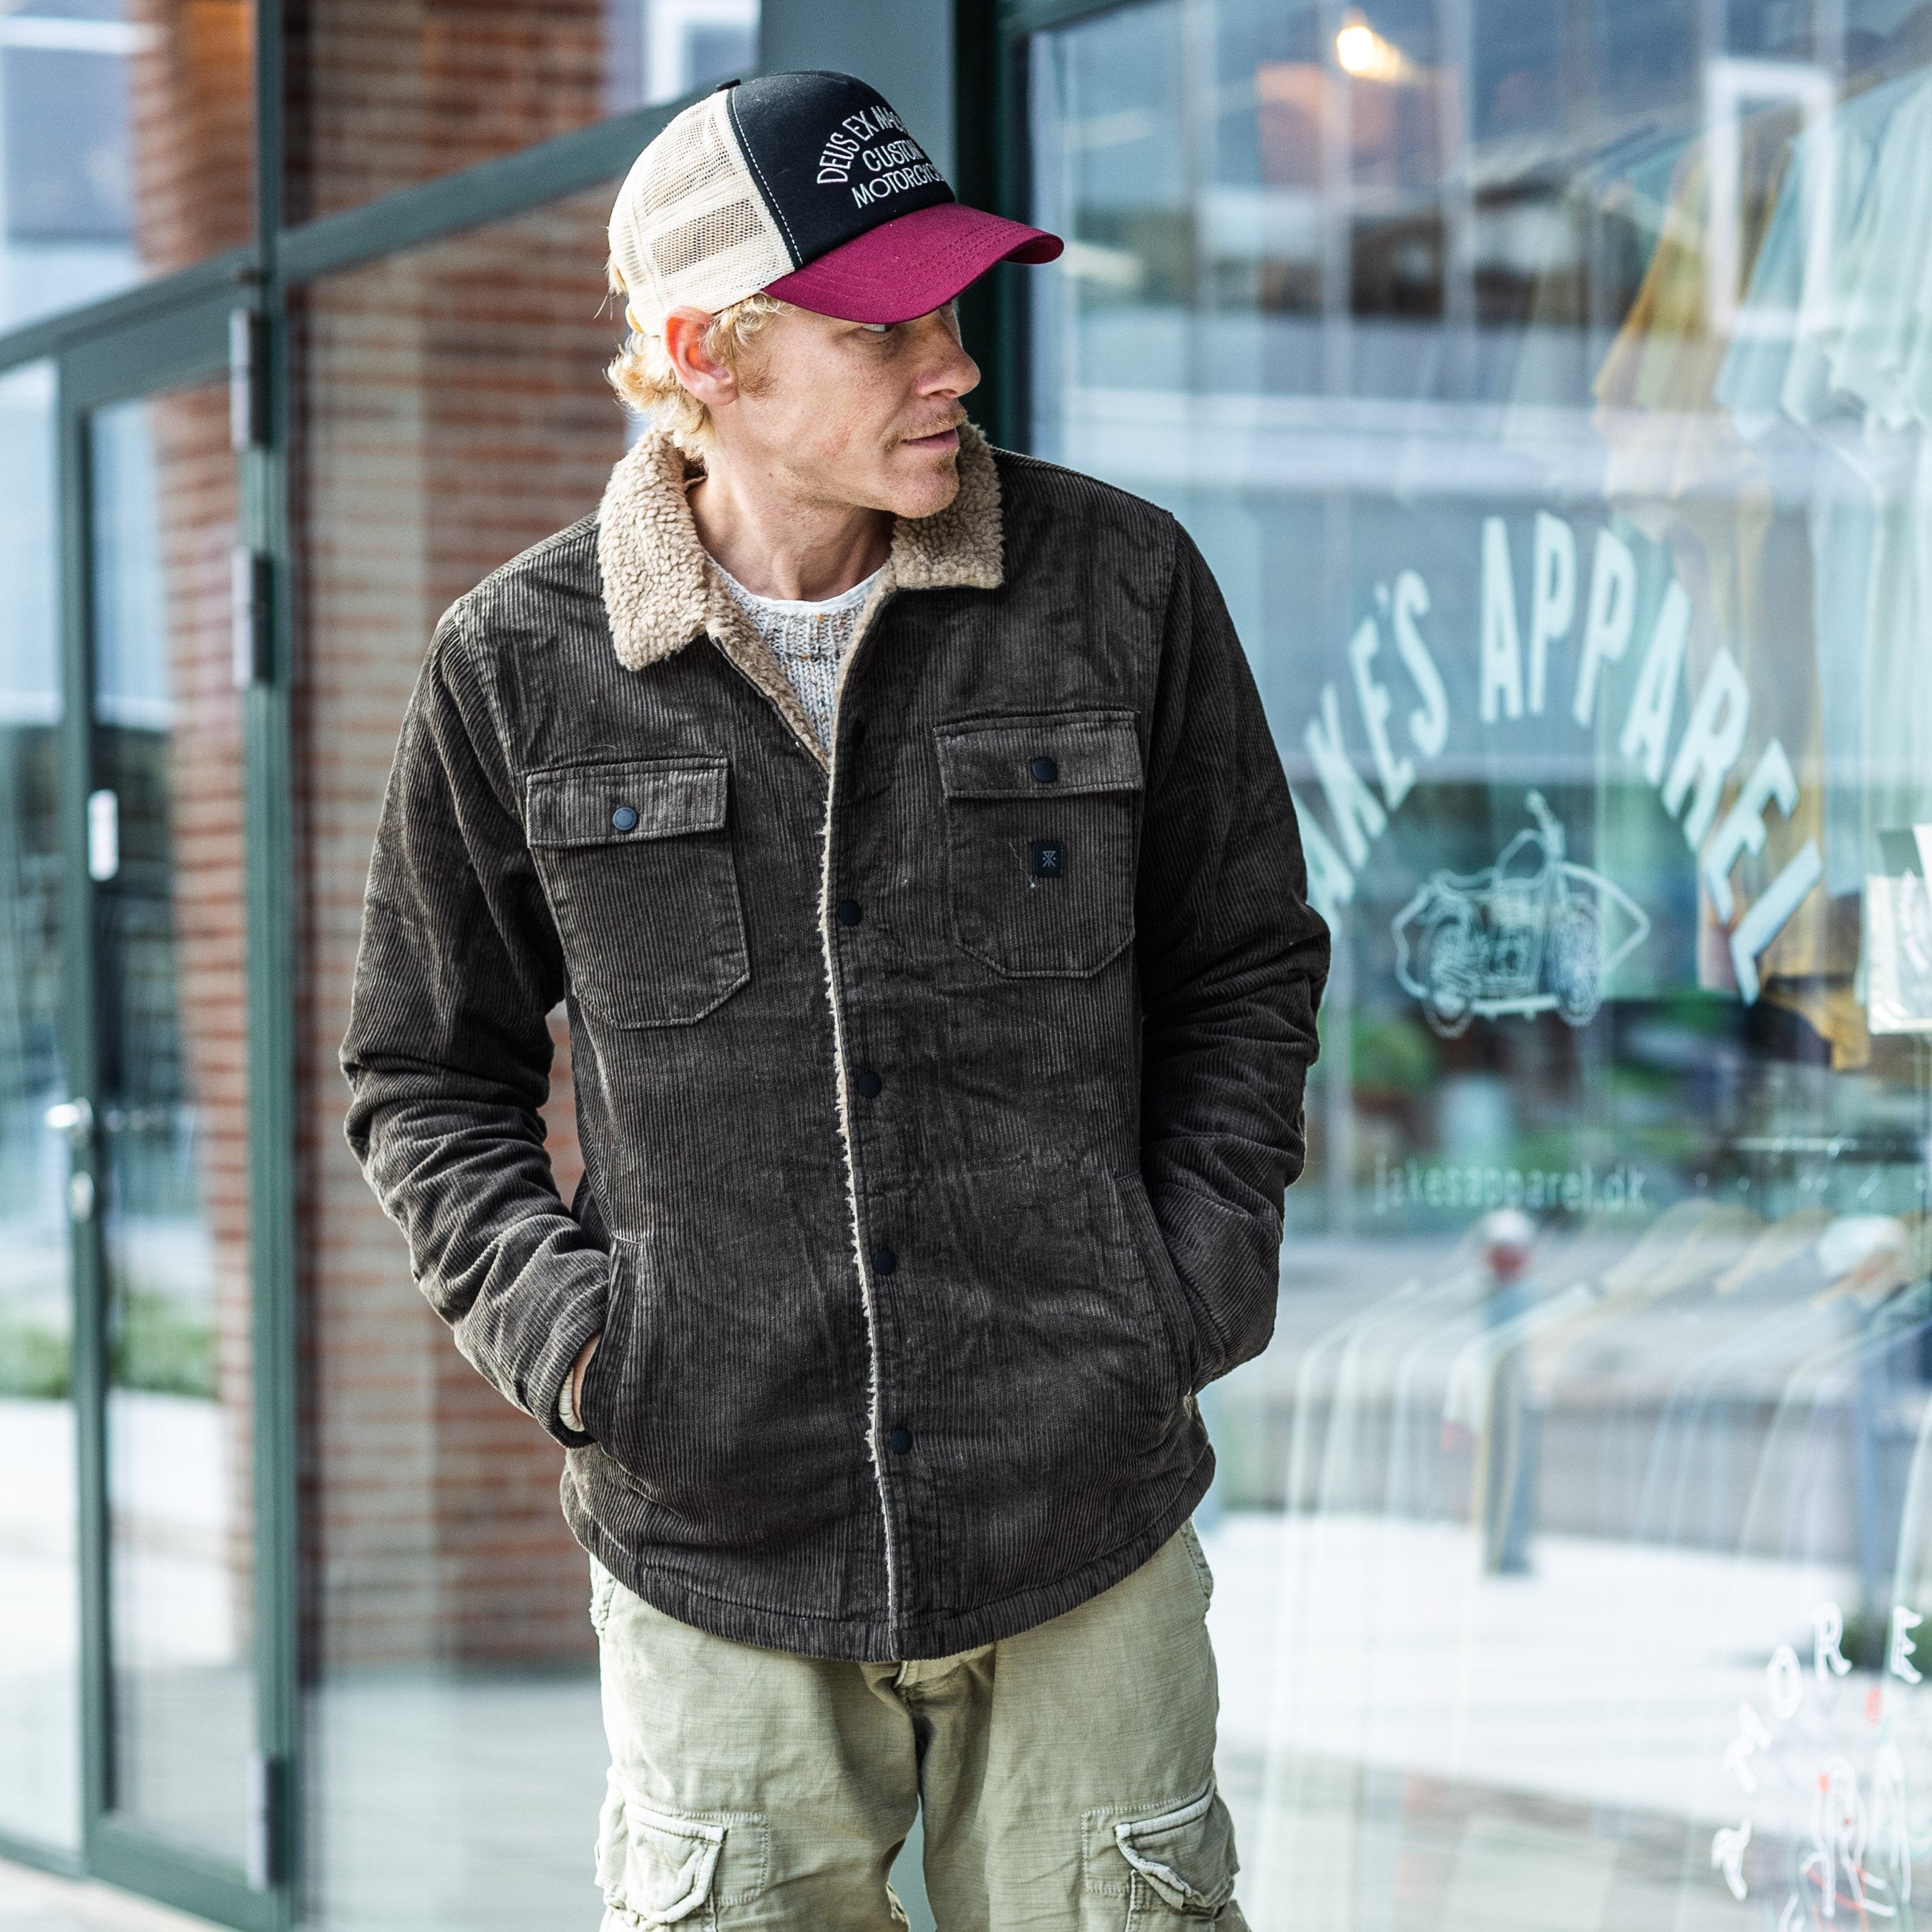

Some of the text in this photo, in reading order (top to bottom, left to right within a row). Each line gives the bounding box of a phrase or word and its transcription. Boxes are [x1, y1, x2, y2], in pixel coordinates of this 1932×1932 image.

[816, 105, 912, 184] DEUS EX MAC
[862, 140, 924, 172] CUSTOM
[852, 162, 945, 209] MOTORCYC
[1289, 509, 1823, 1009] AKE'S APPAREL
